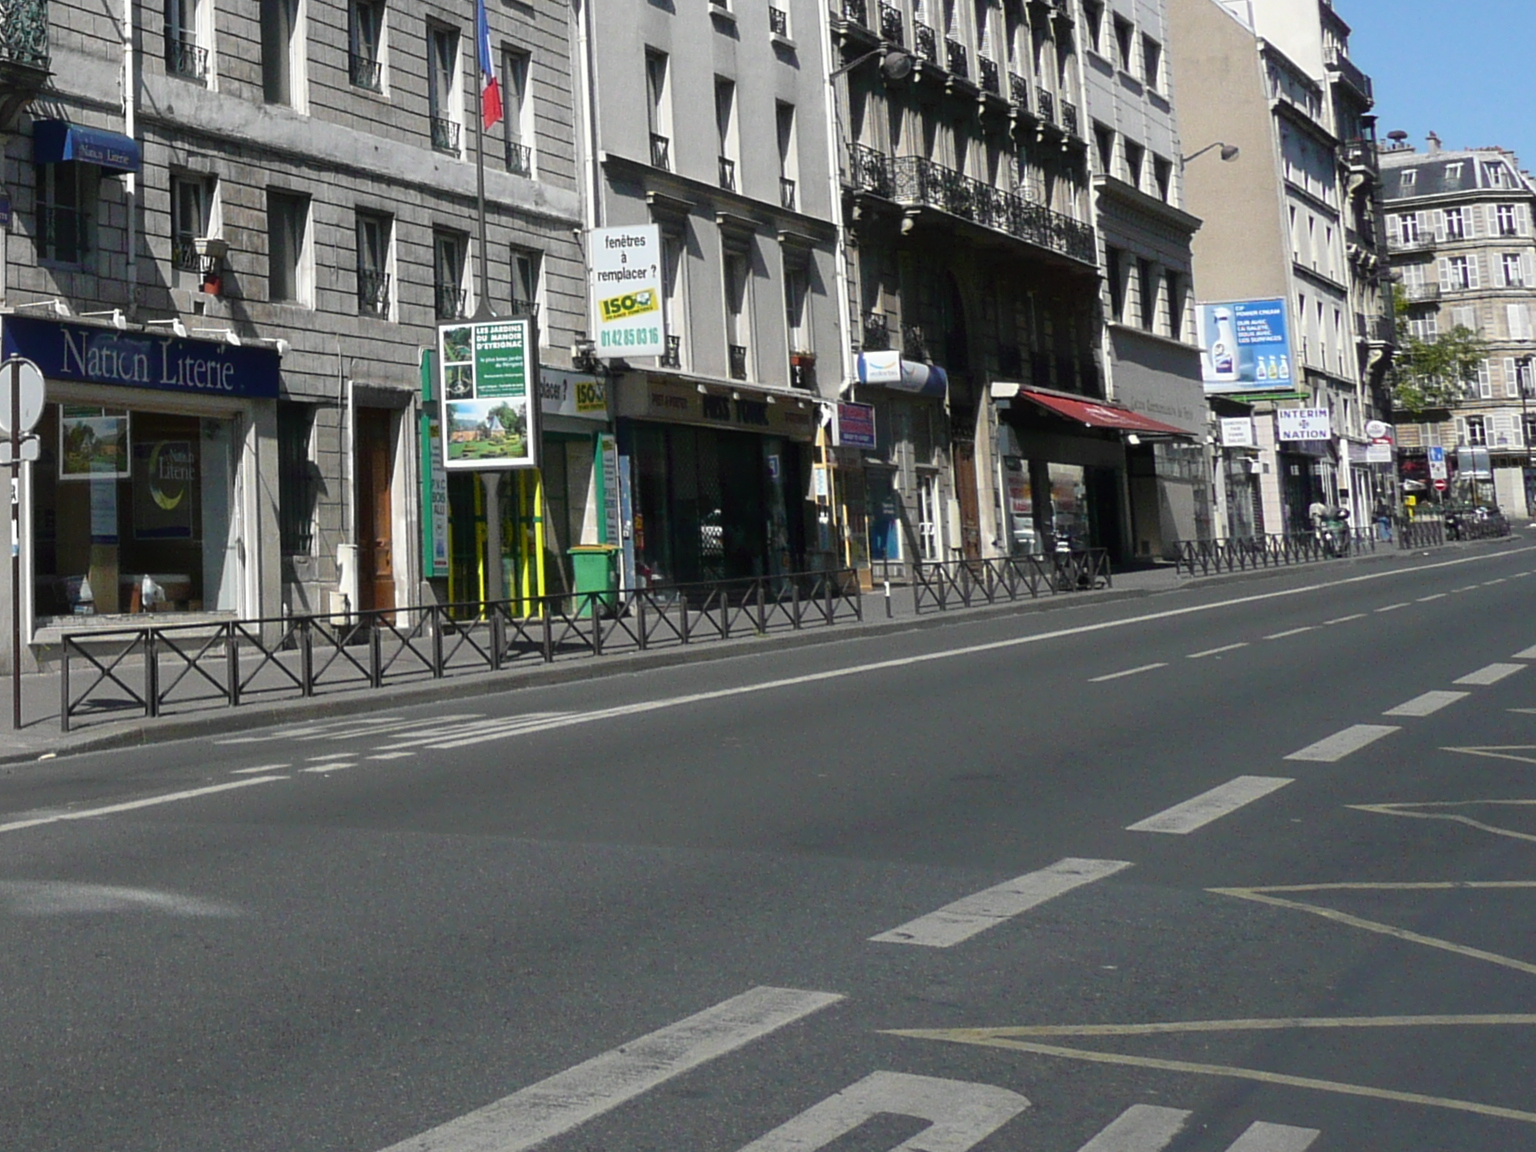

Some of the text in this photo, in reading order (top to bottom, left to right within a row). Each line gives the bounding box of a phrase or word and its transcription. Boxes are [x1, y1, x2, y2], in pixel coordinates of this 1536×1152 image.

[605, 234, 646, 249] fenêtres
[621, 250, 627, 263] à
[597, 264, 657, 282] remplacer ?
[603, 295, 636, 315] ISO
[490, 325, 522, 333] JARDINS
[490, 333, 522, 341] MANOIR
[601, 330, 611, 347] 01
[611, 329, 623, 347] 42
[624, 328, 635, 346] 85
[649, 327, 659, 345] 16
[60, 327, 235, 391] Nation Literie
[576, 383, 596, 403] ISO
[1280, 409, 1328, 419] INTERIM
[1282, 430, 1328, 440] NATION
[159, 455, 195, 481] Literie
